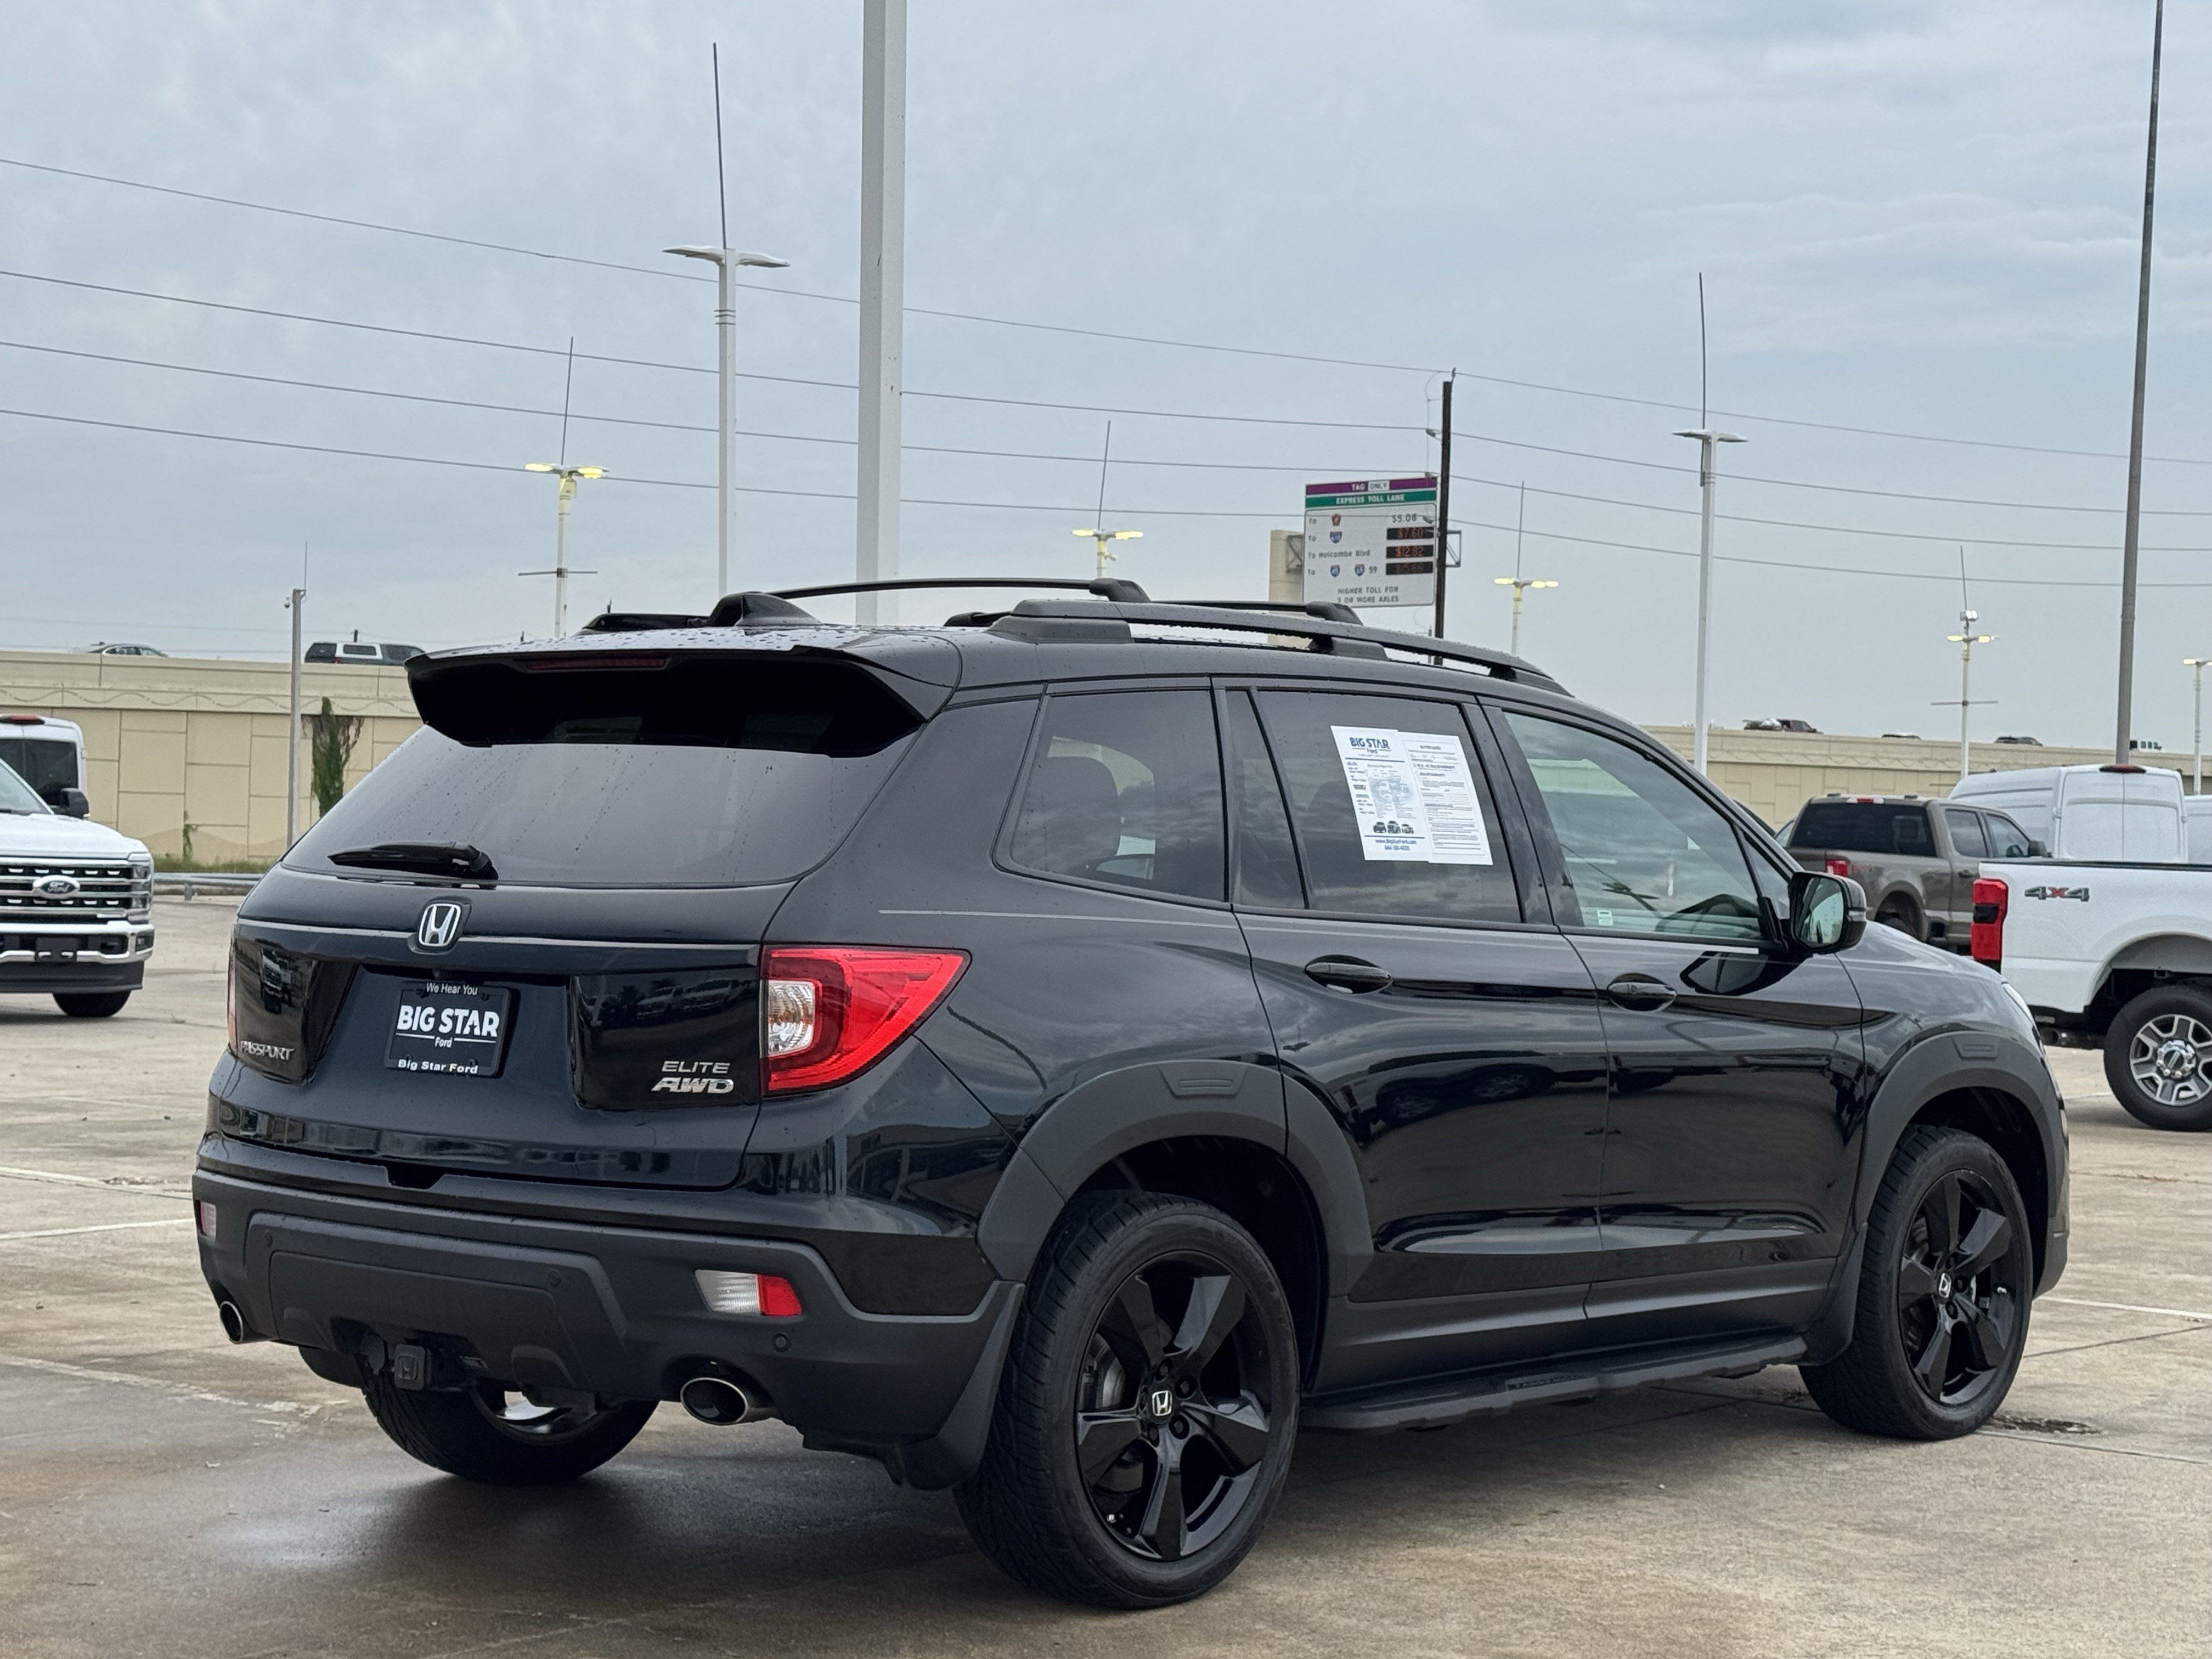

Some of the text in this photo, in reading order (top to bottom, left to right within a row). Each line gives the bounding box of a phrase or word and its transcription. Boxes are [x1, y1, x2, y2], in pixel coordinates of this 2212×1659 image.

[1351, 483, 1366, 492] TAG
[1336, 495, 1365, 505] EXPRESS
[1386, 493, 1405, 501] LANE
[1350, 737, 1391, 749] BIG STAR
[426, 983, 478, 996] We Hear You
[396, 1005, 500, 1037] BIG STAR
[435, 1037, 453, 1048] Ford
[240, 1040, 295, 1060] PASSPORT
[398, 1059, 479, 1075] Big Star Ford
[662, 1060, 731, 1074] ELITE
[651, 1077, 735, 1094] AWD
